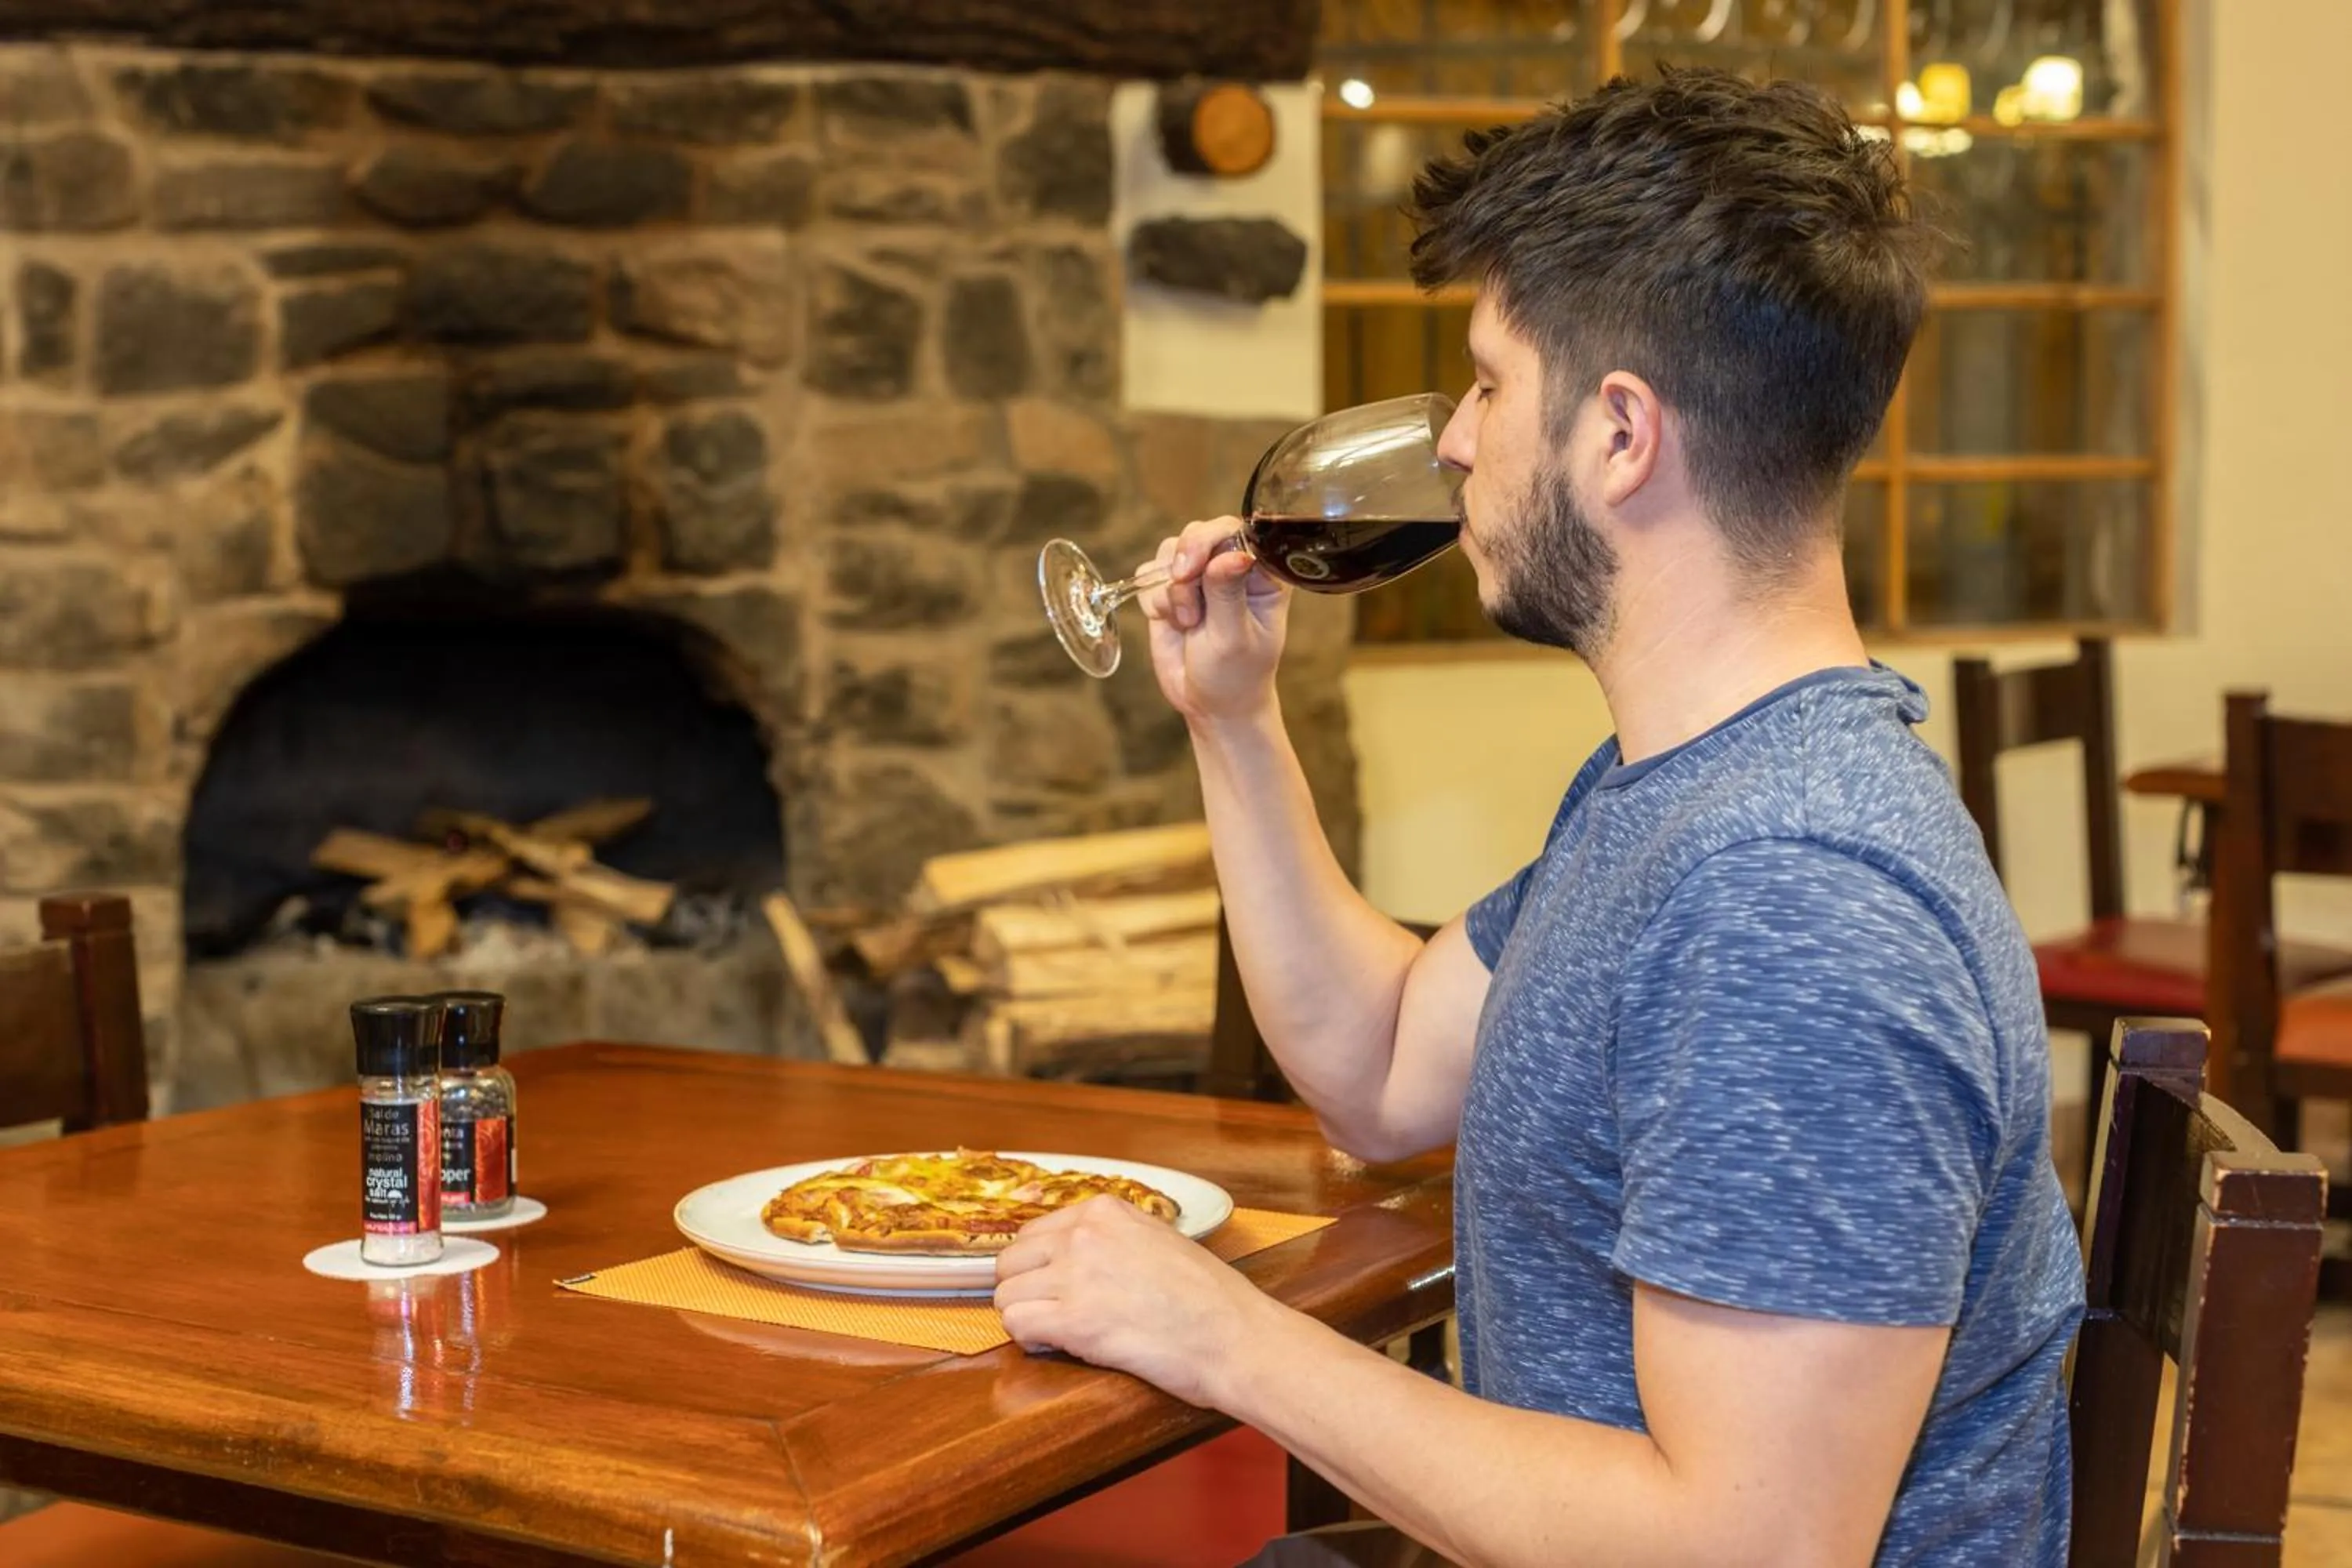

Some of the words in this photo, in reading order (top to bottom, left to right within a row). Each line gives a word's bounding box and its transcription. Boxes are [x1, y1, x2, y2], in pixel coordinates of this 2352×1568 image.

[364, 1119, 409, 1136] Maras
[368, 1167, 403, 1177] natural
[366, 1175, 408, 1189] crystal
[369, 1188, 387, 1199] salt
